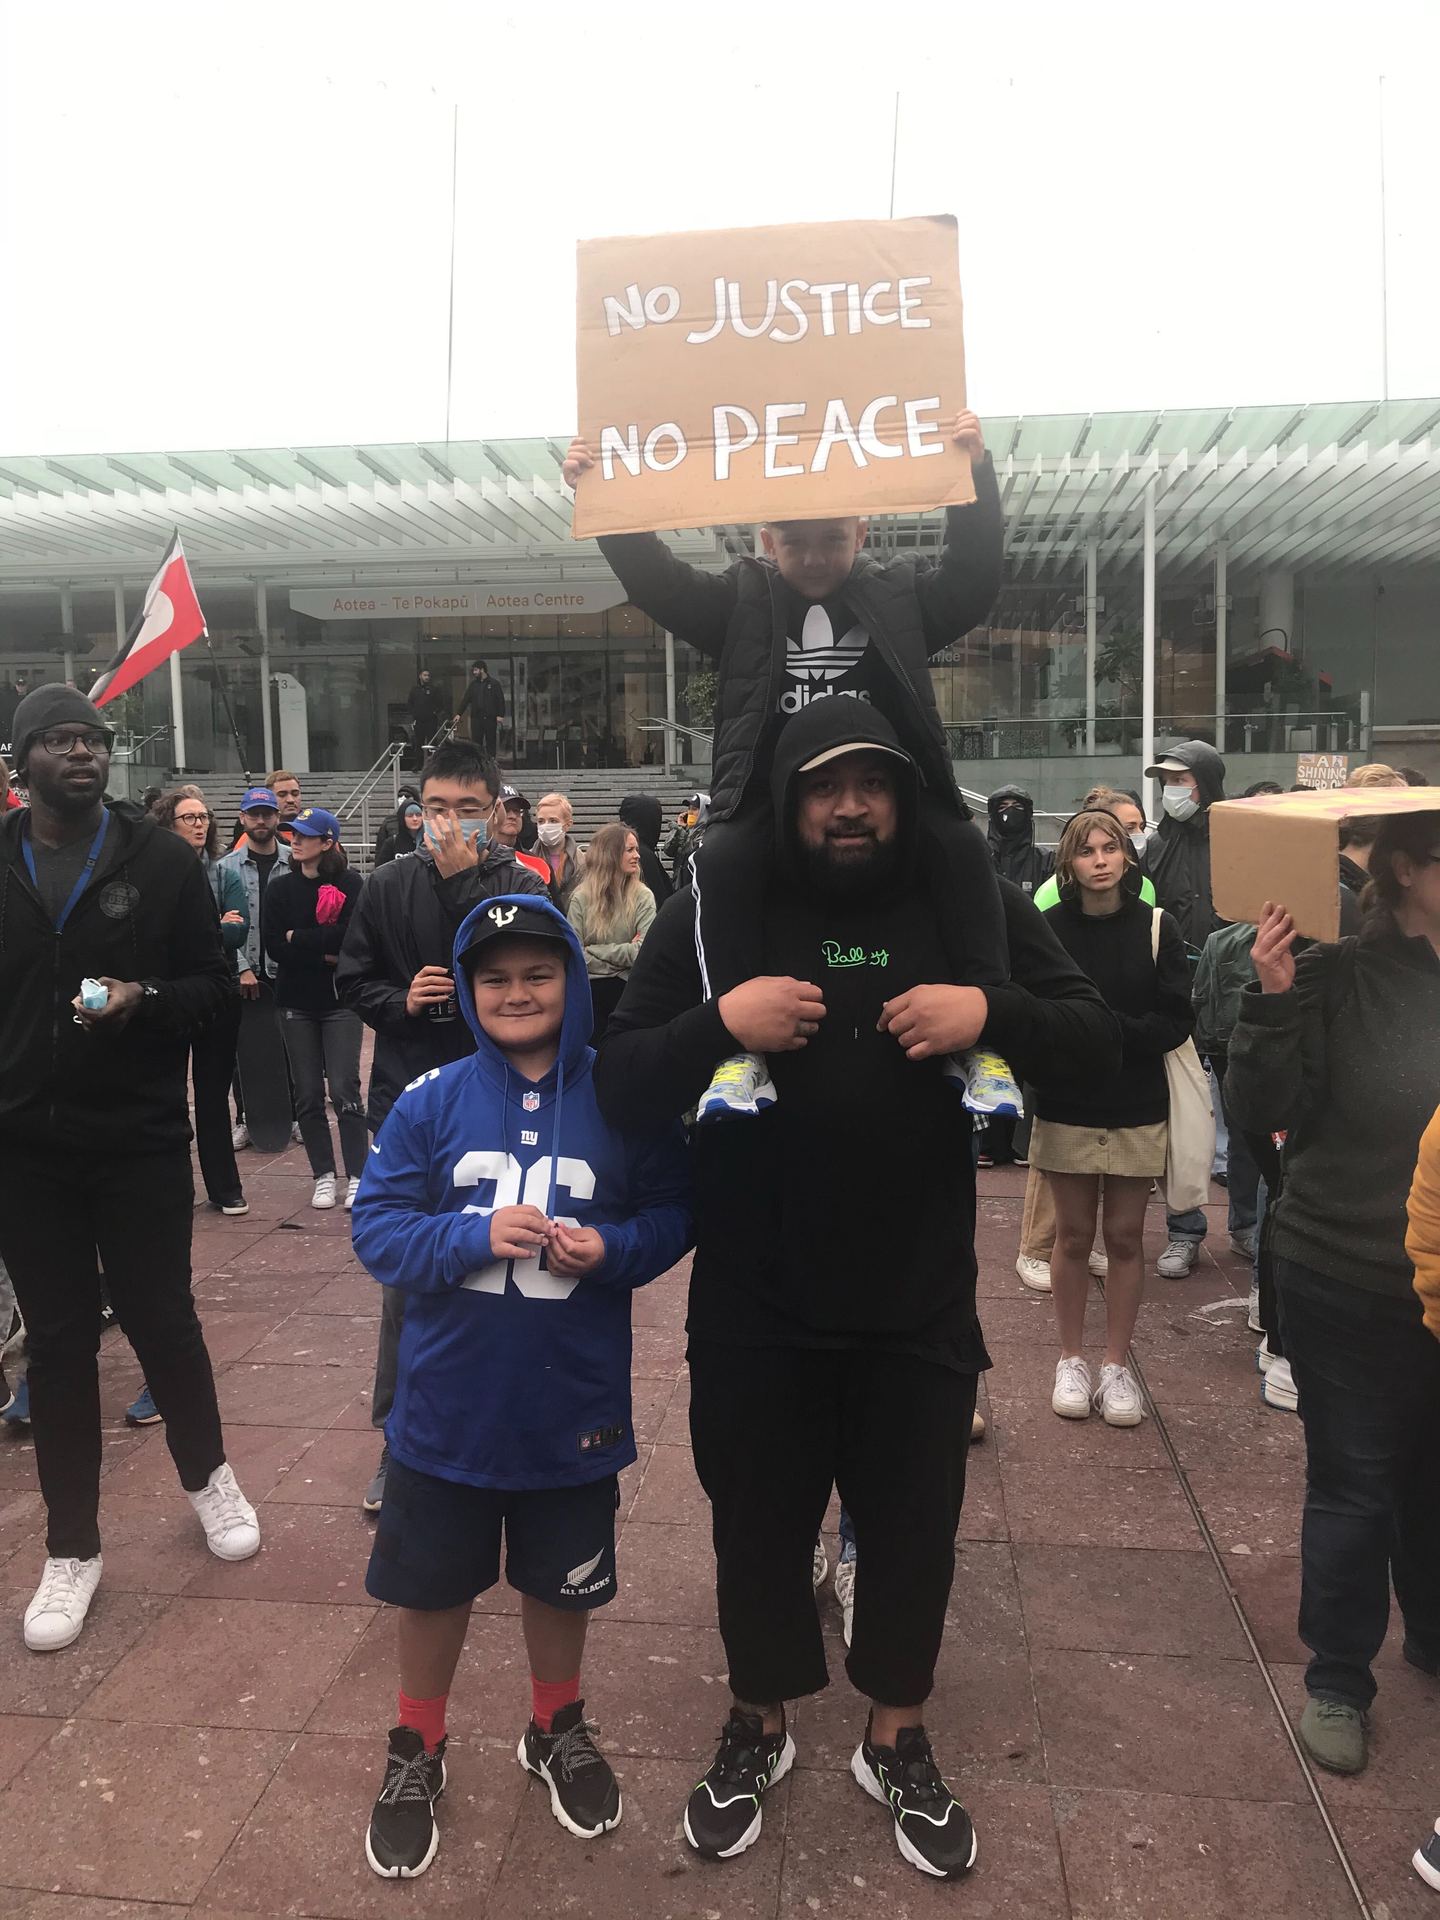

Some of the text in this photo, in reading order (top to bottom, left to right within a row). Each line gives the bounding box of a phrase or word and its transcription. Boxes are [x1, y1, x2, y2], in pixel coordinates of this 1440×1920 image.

[603, 275, 932, 344] NO JUSTICE
[601, 395, 944, 481] NO PEACE
[333, 598, 376, 611] Aotea
[392, 596, 409, 609] Te
[486, 592, 585, 608] Aotea Centre
[281, 680, 288, 689] 3
[1317, 756, 1329, 767] A
[1297, 766, 1346, 780] SHINING
[560, 1576, 610, 1595] ALL BLACKS
